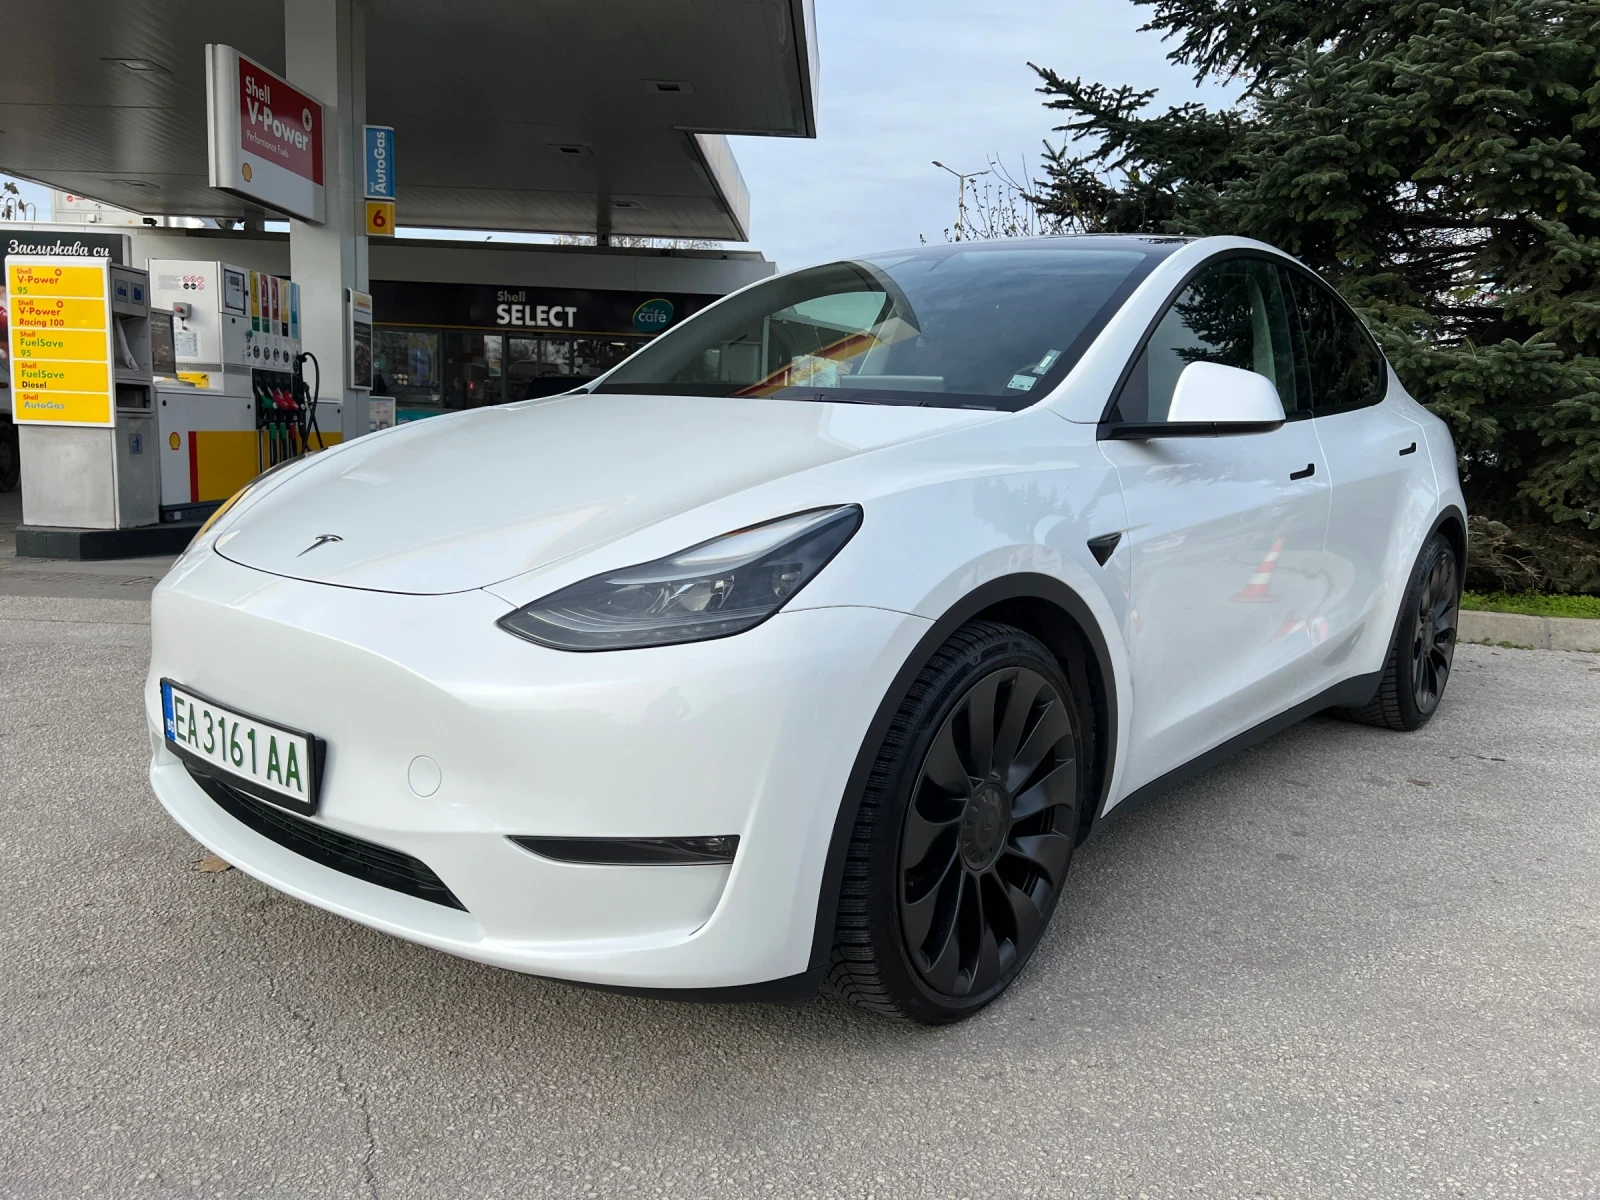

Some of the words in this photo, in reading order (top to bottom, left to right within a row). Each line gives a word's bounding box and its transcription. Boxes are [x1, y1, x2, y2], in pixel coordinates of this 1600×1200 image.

[246, 76, 271, 105] Shell
[246, 96, 308, 151] V-Power
[247, 129, 277, 153] Performance
[278, 144, 289, 159] Fuels
[374, 131, 386, 194] AutoGas
[372, 209, 386, 228] 6
[93, 247, 110, 257] си
[17, 275, 59, 284] V-Power
[17, 286, 28, 294] 95
[497, 290, 526, 302] Shell
[19, 307, 61, 316] V-Power
[496, 303, 577, 328] SELECT
[638, 310, 667, 323] café
[19, 318, 47, 328] Racing
[49, 318, 64, 327] 100
[20, 338, 64, 348] FuelSave
[21, 349, 31, 357] 95
[21, 369, 65, 379] FuelSave
[22, 381, 47, 389] Diesel
[23, 401, 65, 409] AutoGas
